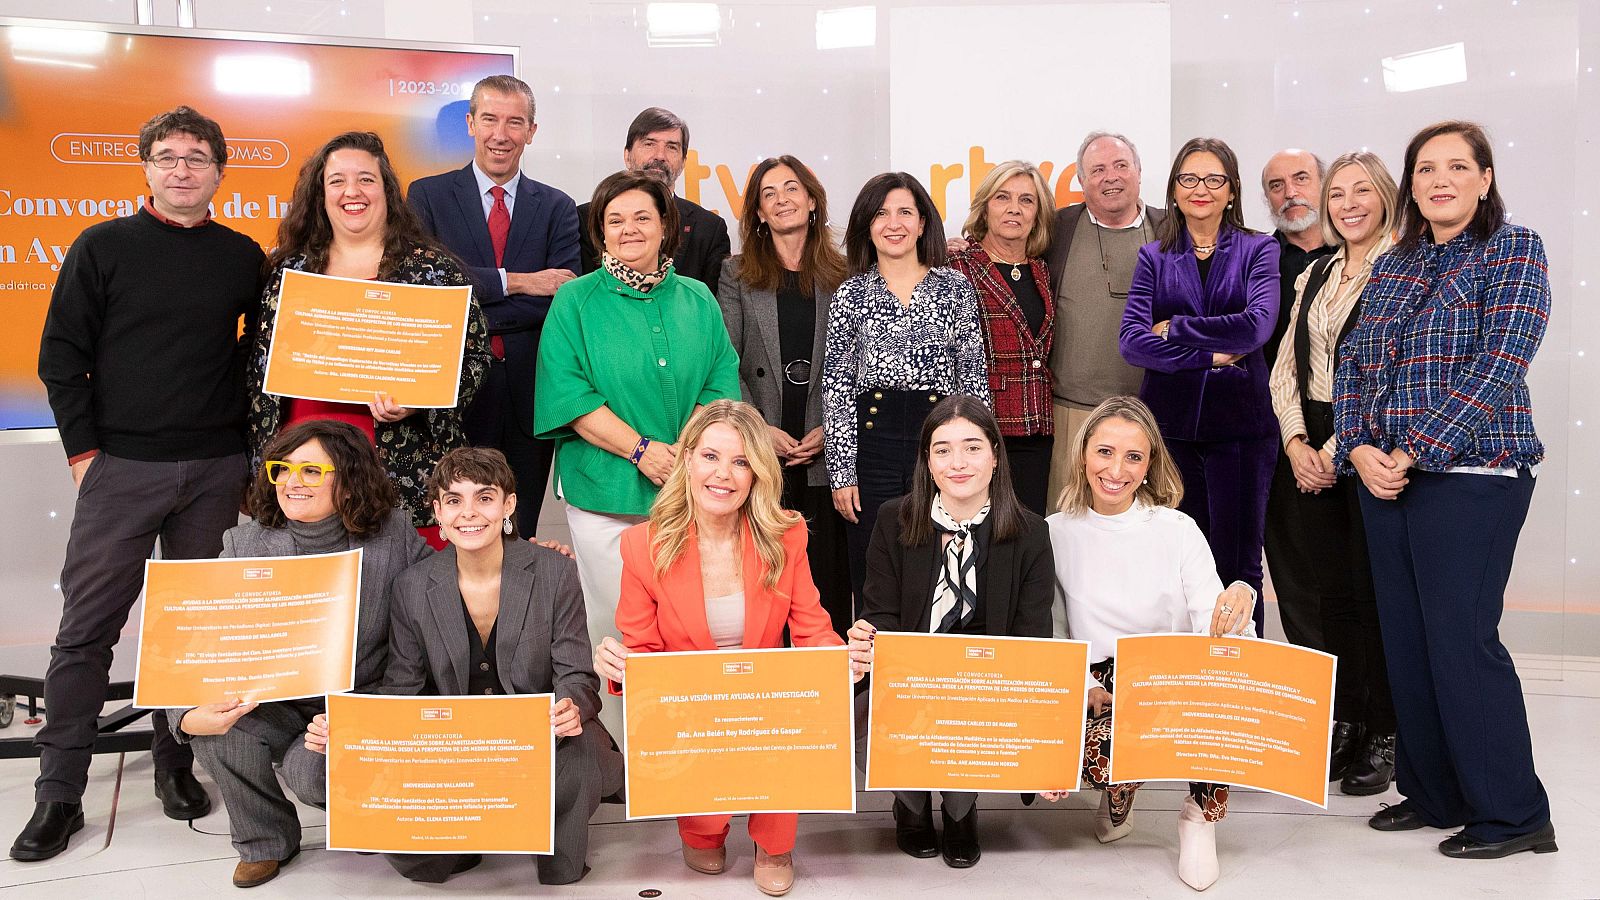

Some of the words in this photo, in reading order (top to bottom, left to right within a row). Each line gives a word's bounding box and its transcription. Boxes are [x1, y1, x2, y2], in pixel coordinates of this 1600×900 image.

[398, 81, 461, 96] 2023-20
[70, 141, 140, 157] ENTREG
[226, 146, 273, 160] OMAS
[0, 190, 146, 218] onvocat
[223, 192, 260, 218] de
[0, 280, 46, 290] ediática
[690, 693, 712, 702] VISIÓN
[771, 690, 819, 699] INVESTIGACIÓN
